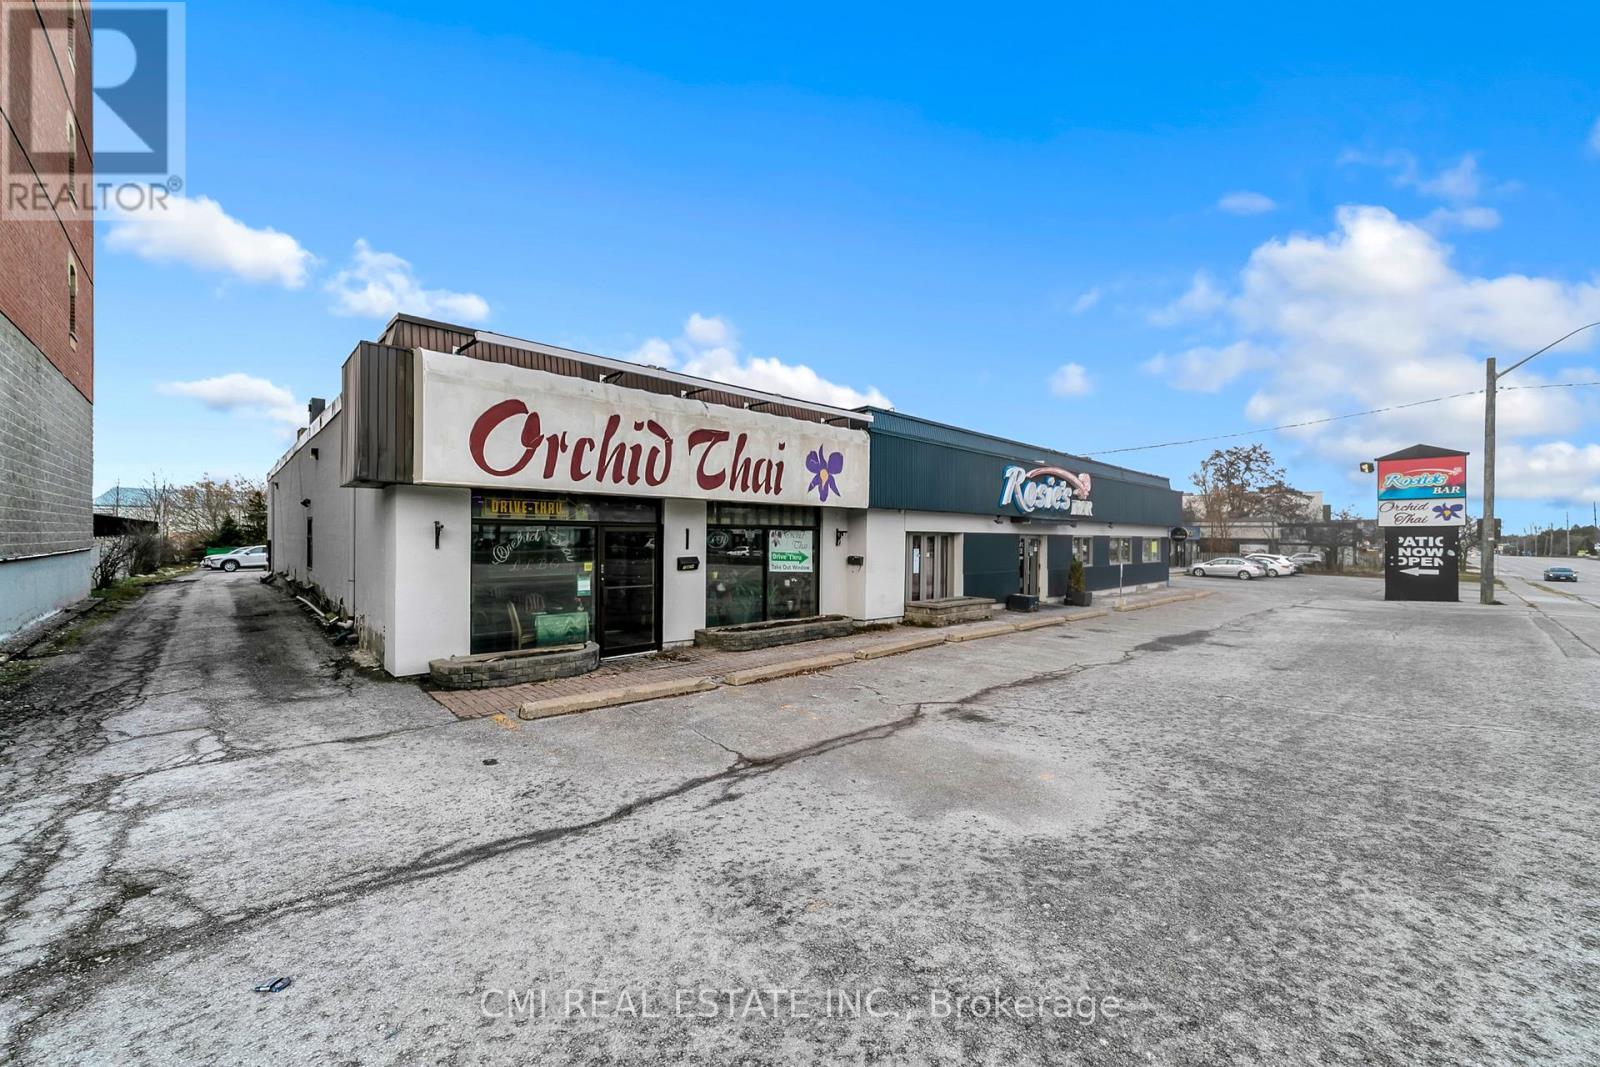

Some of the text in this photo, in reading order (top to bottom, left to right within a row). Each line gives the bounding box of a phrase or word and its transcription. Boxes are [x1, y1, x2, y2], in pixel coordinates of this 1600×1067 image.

[469, 399, 786, 496] Orchid Thai
[1384, 473, 1448, 489] Rosie's
[999, 464, 1072, 513] Rosie's
[1433, 486, 1461, 495] BAR
[491, 499, 563, 514] DRIVE-THRU
[1379, 502, 1430, 513] Orchid
[1394, 512, 1429, 525] Thai
[772, 552, 802, 561] Drive Thru
[1398, 547, 1444, 557] NOW
